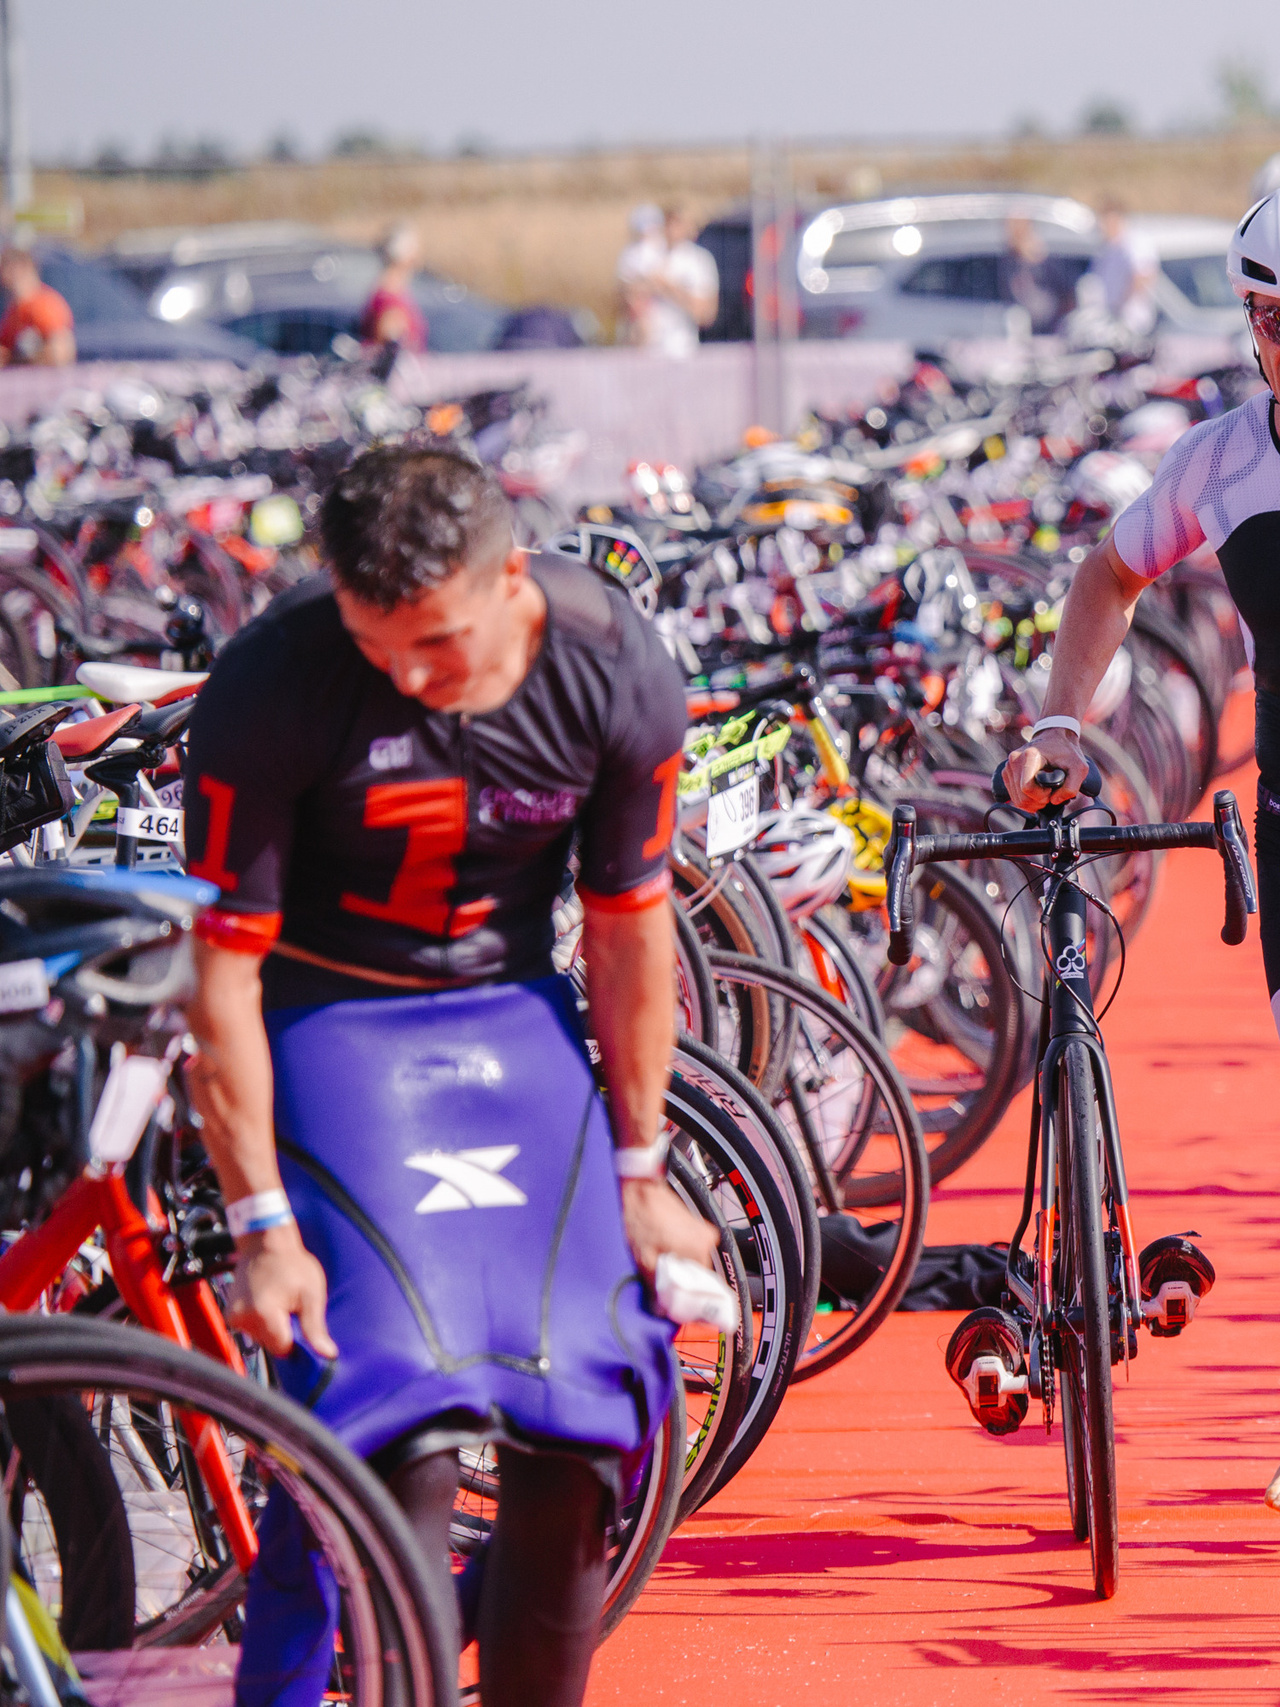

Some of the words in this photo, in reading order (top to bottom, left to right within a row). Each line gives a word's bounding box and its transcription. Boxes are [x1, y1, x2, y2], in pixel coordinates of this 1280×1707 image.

[139, 814, 179, 837] 464
[641, 749, 685, 861] 1
[190, 775, 238, 892] 1
[1231, 844, 1252, 899] ULTEGRA
[778, 1332, 792, 1375] ULTRA
